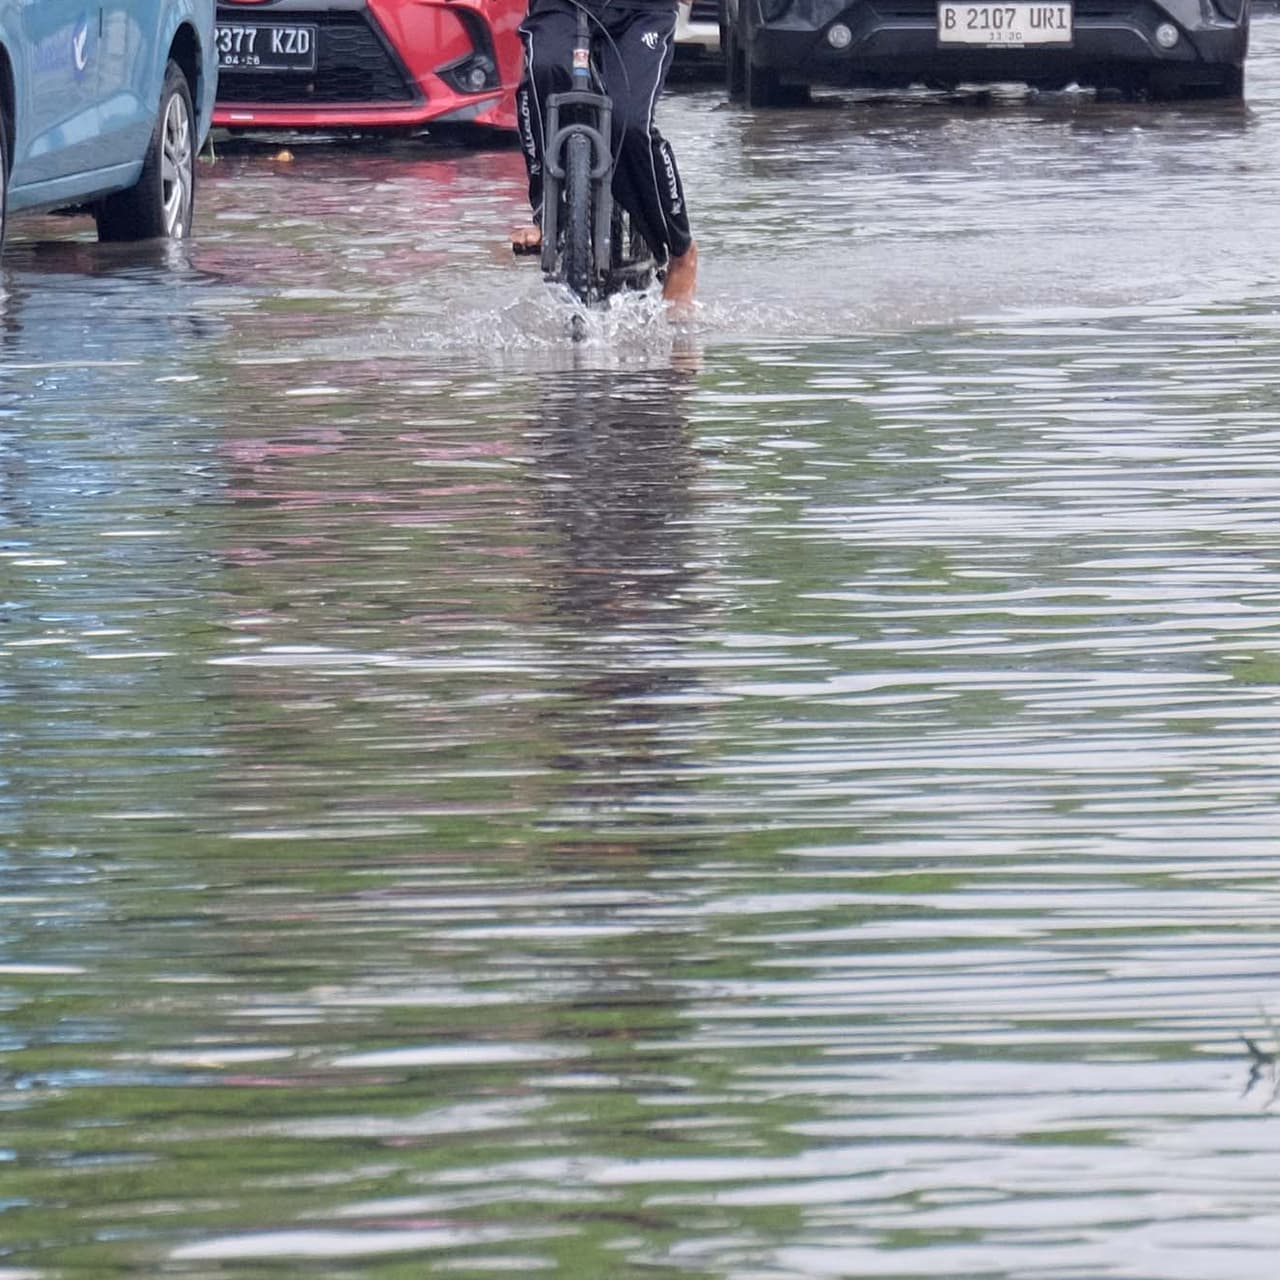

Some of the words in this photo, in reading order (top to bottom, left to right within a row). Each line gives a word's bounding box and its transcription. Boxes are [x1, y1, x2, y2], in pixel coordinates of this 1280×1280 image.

[945, 8, 956, 29] B
[967, 8, 1016, 29] 2107
[1030, 8, 1067, 29] URI
[272, 29, 310, 54] KZD
